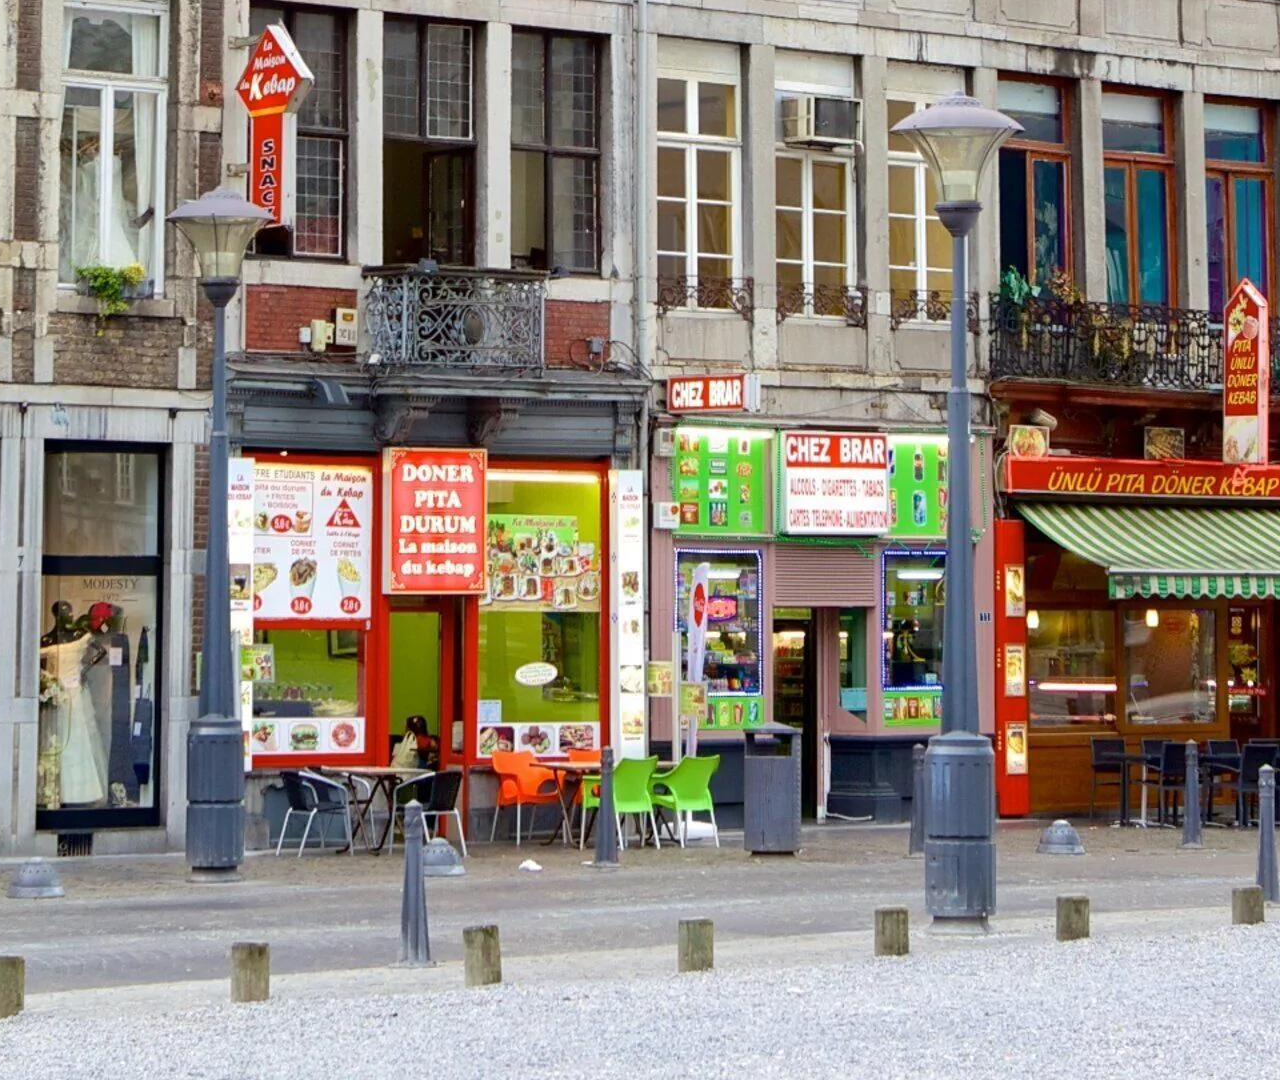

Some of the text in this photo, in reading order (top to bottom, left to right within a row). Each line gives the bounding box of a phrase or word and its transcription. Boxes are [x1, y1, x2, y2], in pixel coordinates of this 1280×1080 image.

[263, 38, 272, 52] La
[253, 53, 286, 71] Maison
[249, 72, 296, 101] Kebap
[1233, 339, 1252, 353] PITA
[1231, 353, 1255, 370] ÜNLÜ
[1228, 371, 1257, 388] DÖNER
[672, 380, 742, 407] CHEZ BRAR
[786, 437, 885, 463] CHEZ BRAR
[274, 470, 315, 480] ETUDIANTS
[320, 472, 366, 483] La Maison
[402, 464, 474, 482] DONER
[1048, 466, 1280, 496] ÜNLÜ PITA DÖNER KEBAP
[790, 478, 816, 495] ALCOOLS
[414, 490, 462, 508] PITA
[400, 515, 476, 534] DURUM
[398, 538, 477, 554] La maison
[401, 560, 475, 577] du kebap
[83, 578, 138, 589] MODESTY
